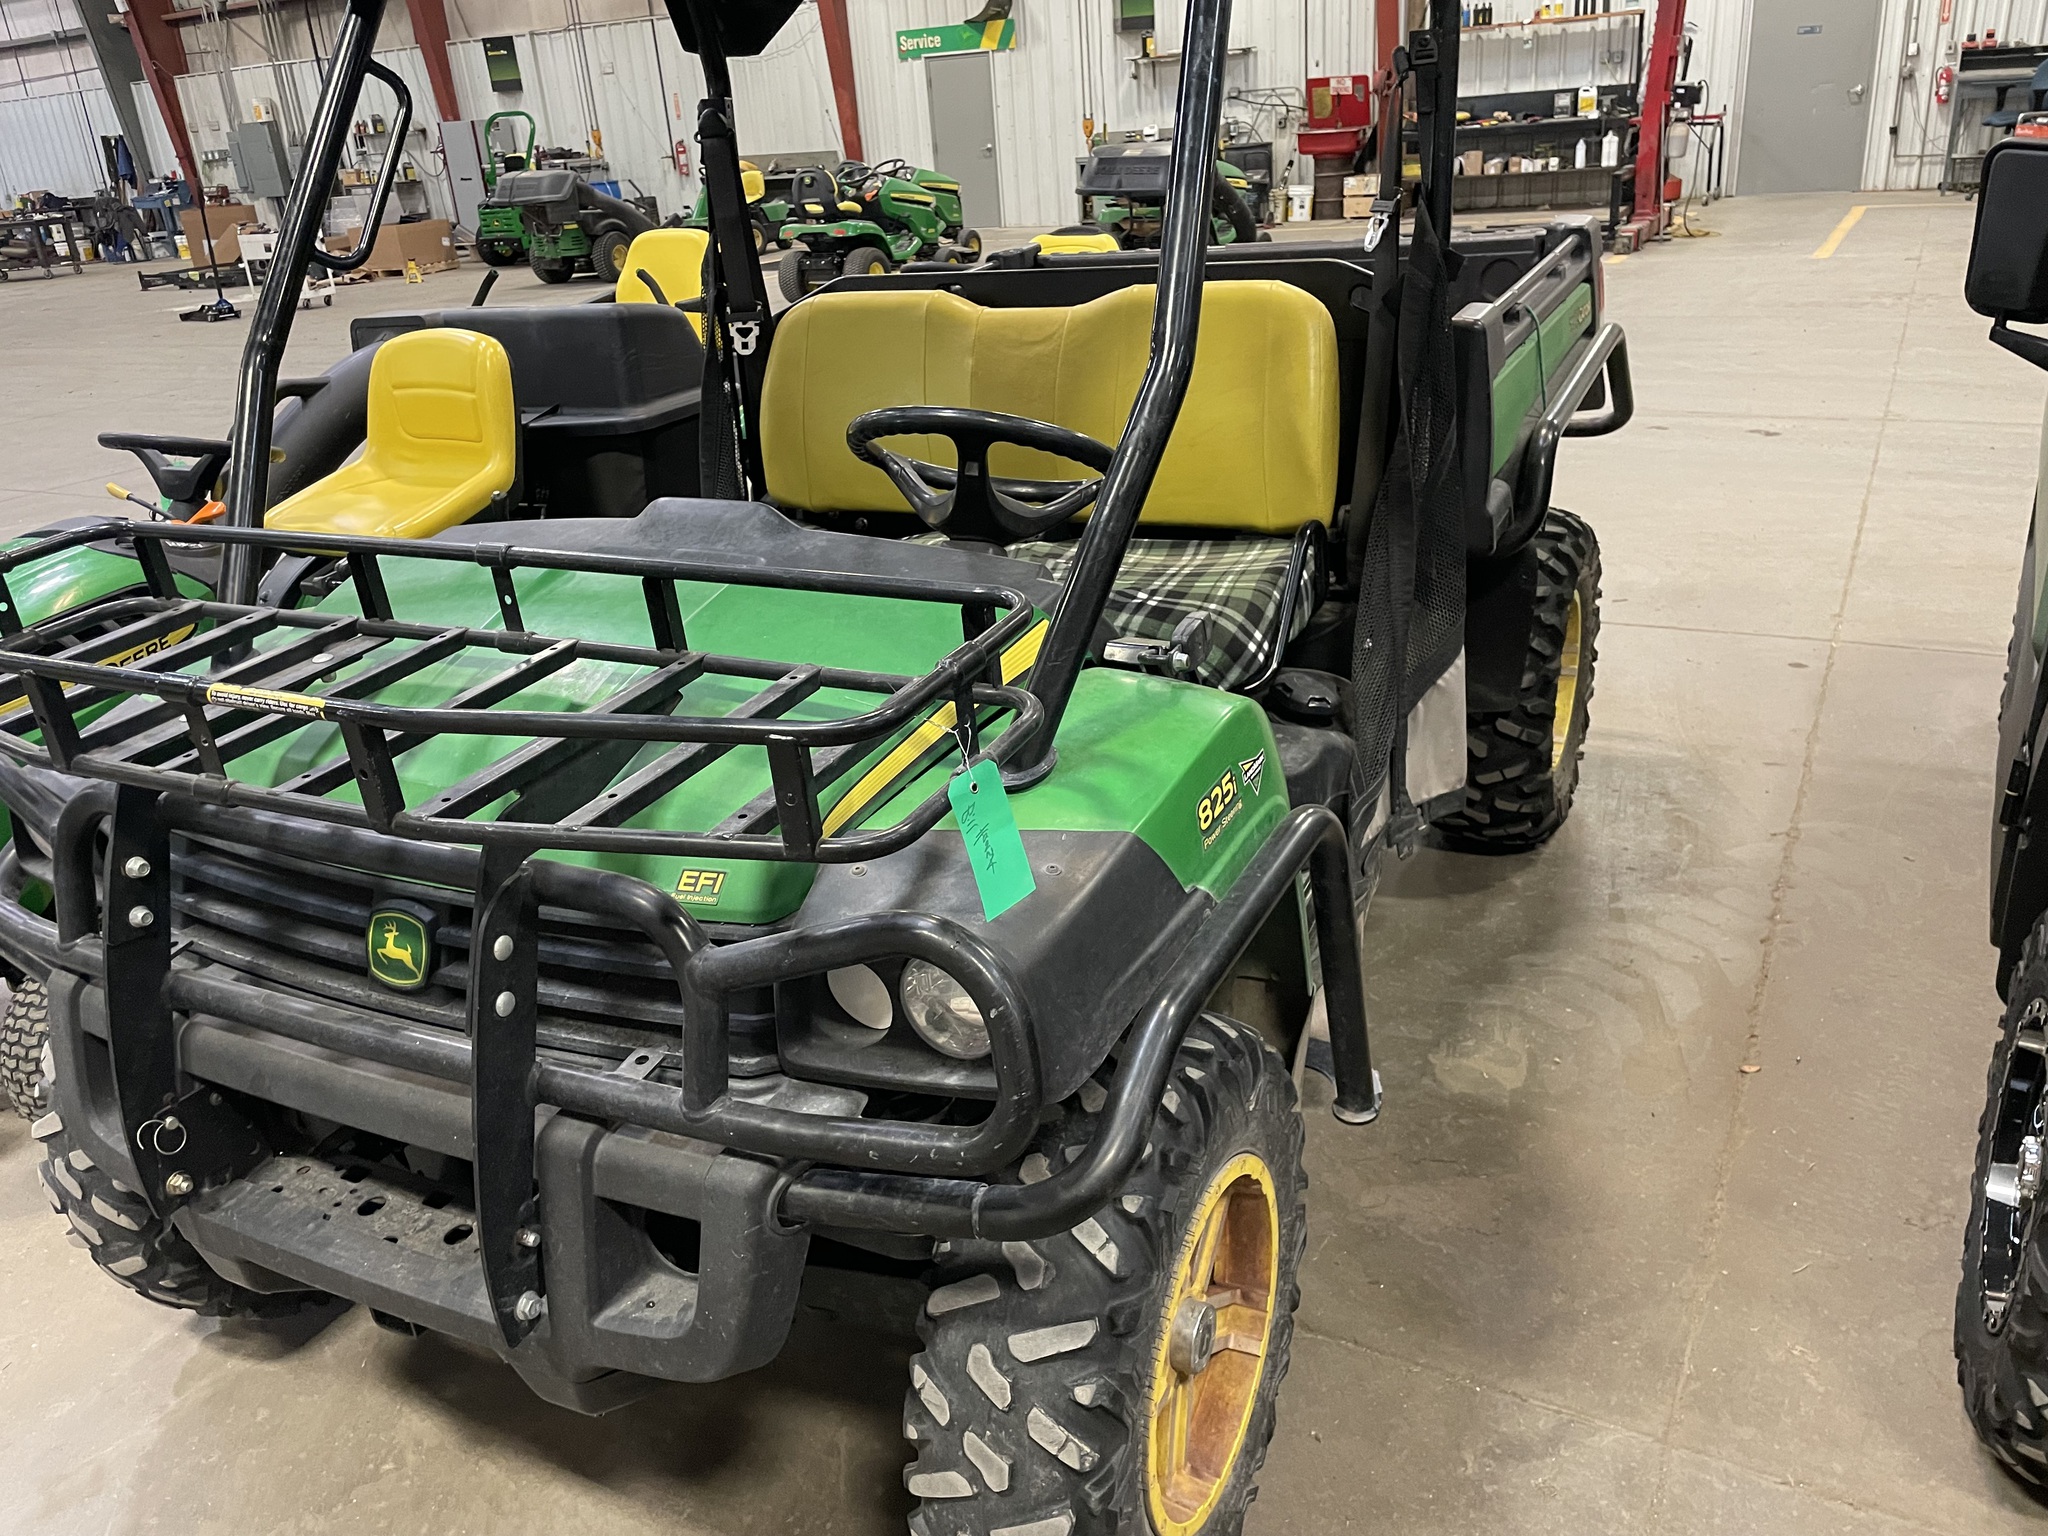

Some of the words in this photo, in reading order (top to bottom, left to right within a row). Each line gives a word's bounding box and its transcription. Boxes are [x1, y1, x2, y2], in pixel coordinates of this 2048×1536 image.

[899, 33, 942, 51] Service
[1198, 770, 1238, 831] 825i
[1204, 825, 1221, 850] Power
[1221, 799, 1242, 829] Steering
[677, 870, 725, 894] EFI
[671, 892, 686, 900] Fuel
